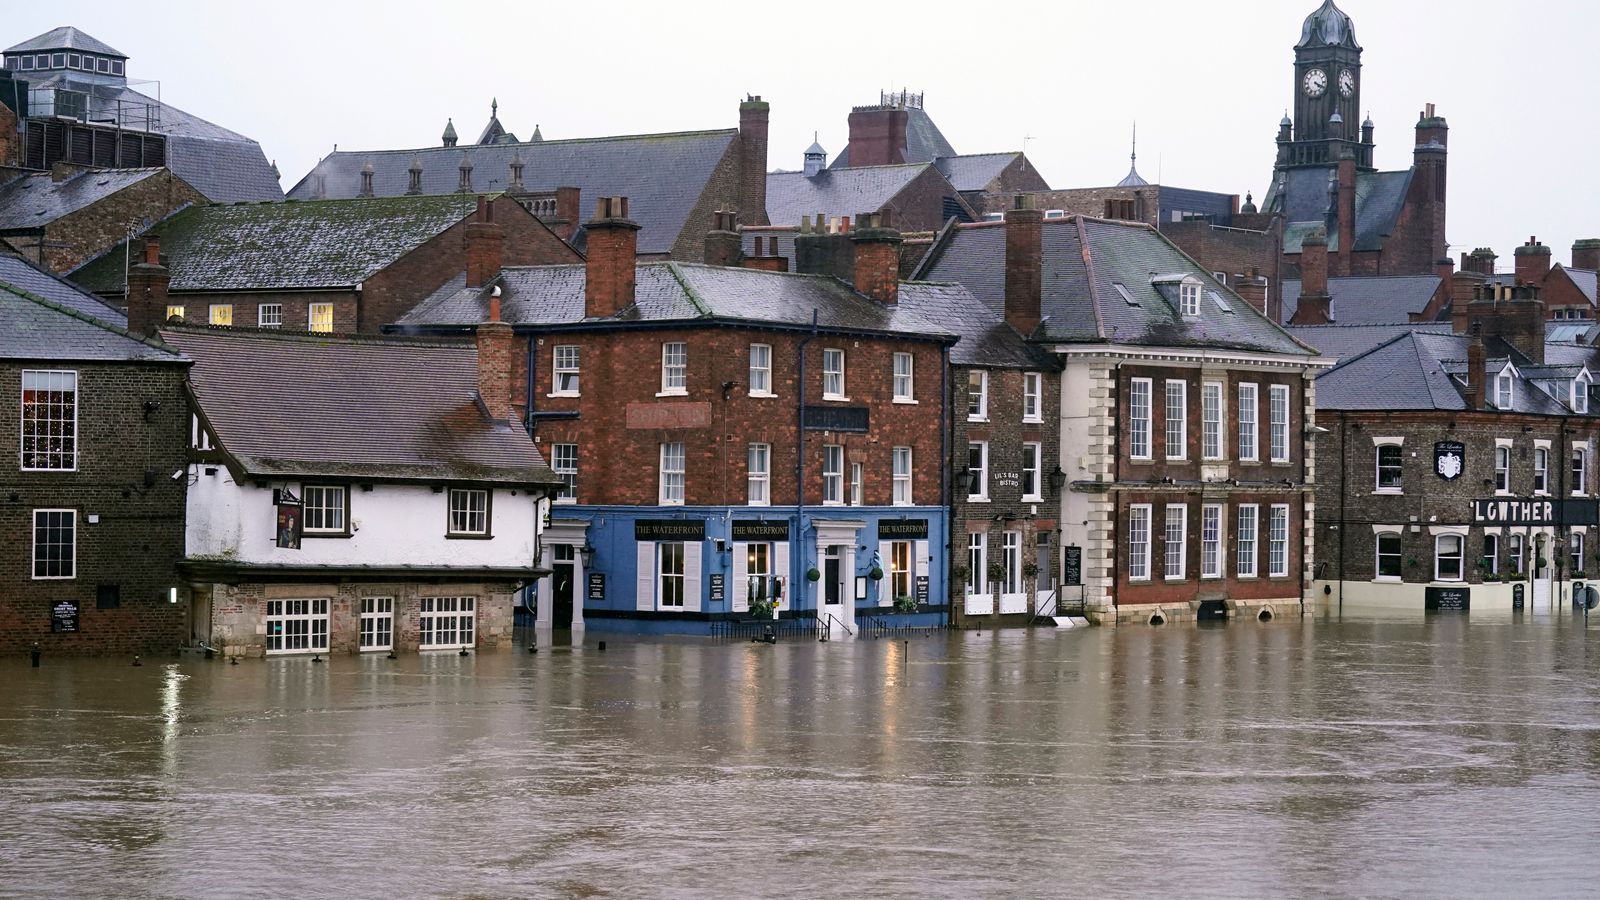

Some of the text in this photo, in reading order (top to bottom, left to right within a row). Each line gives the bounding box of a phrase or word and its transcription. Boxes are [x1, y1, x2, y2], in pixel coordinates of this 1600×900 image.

[1475, 501, 1552, 521] LOWTHER
[636, 525, 704, 535] THE WATERFRONT
[732, 526, 789, 535] THE WATERFRONT
[880, 525, 928, 533] THE WATERFRONT
